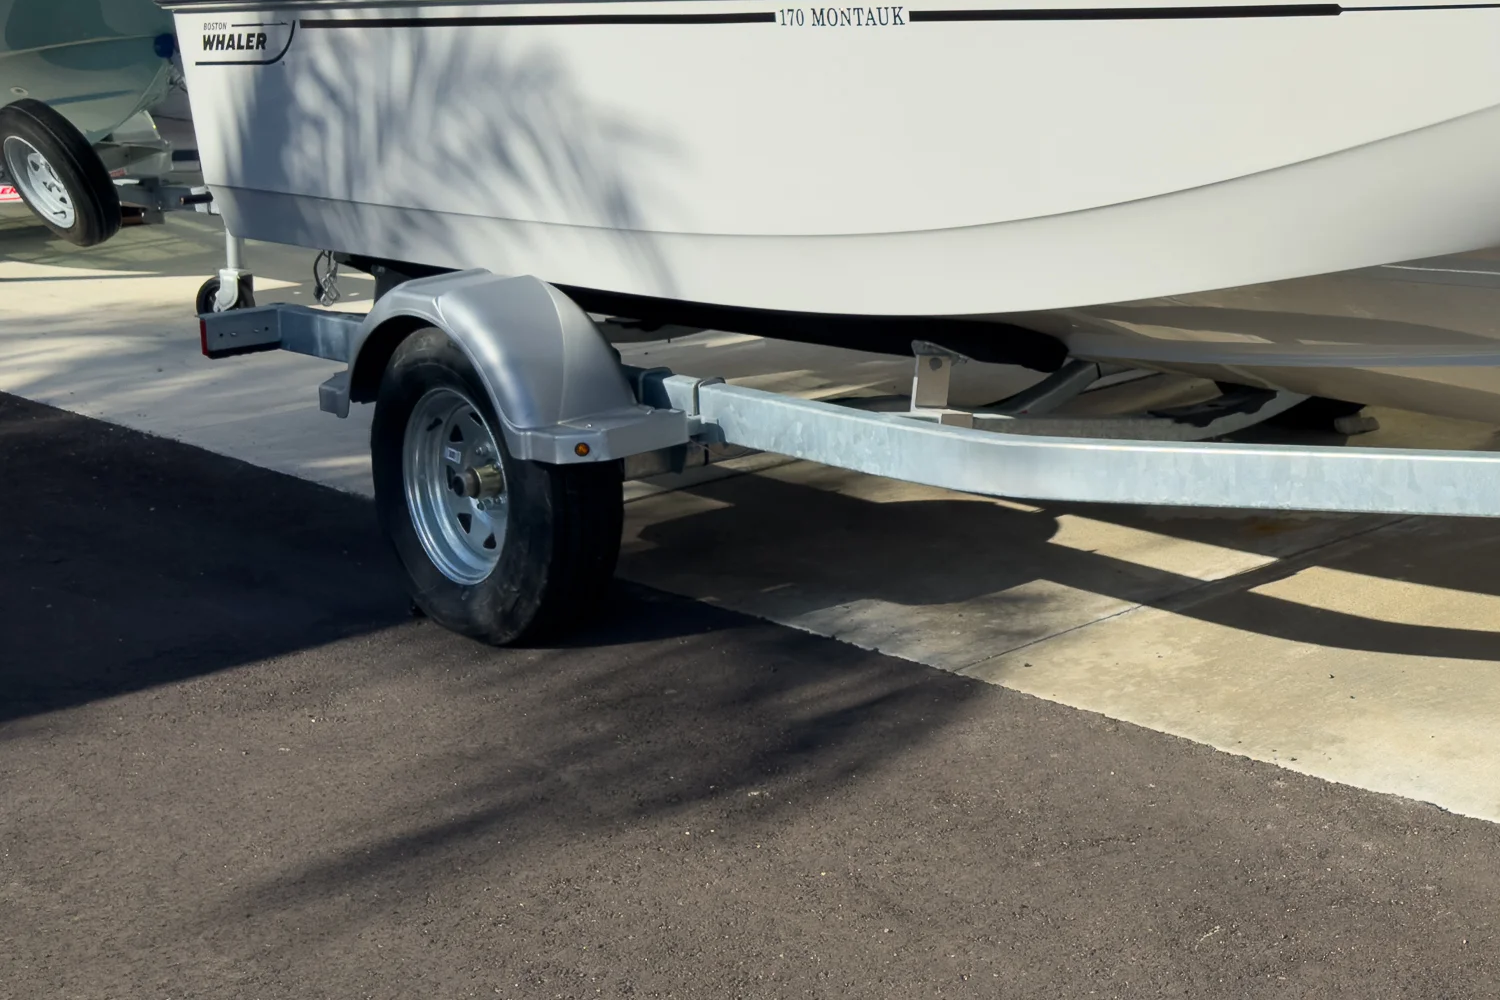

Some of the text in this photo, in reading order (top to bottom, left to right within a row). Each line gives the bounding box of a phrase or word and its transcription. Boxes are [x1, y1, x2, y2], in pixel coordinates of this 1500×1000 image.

[779, 6, 905, 26] 170 MONTAUK
[203, 22, 227, 30] BOSTON
[203, 33, 267, 51] WHALER
